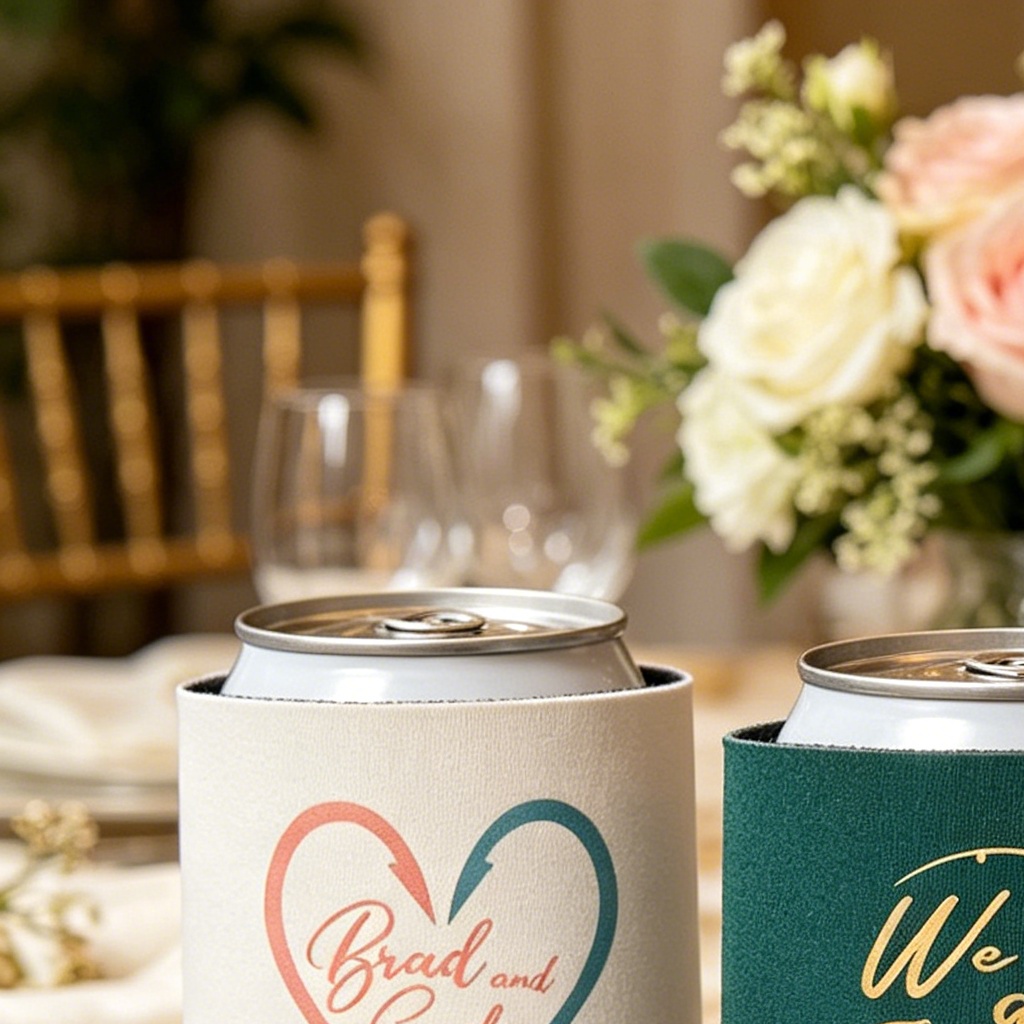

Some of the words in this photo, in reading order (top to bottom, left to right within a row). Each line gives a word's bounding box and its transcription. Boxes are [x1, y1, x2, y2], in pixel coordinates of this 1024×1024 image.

[307, 899, 493, 1014] Brad
[490, 956, 559, 994] and
[861, 889, 1018, 999] We
